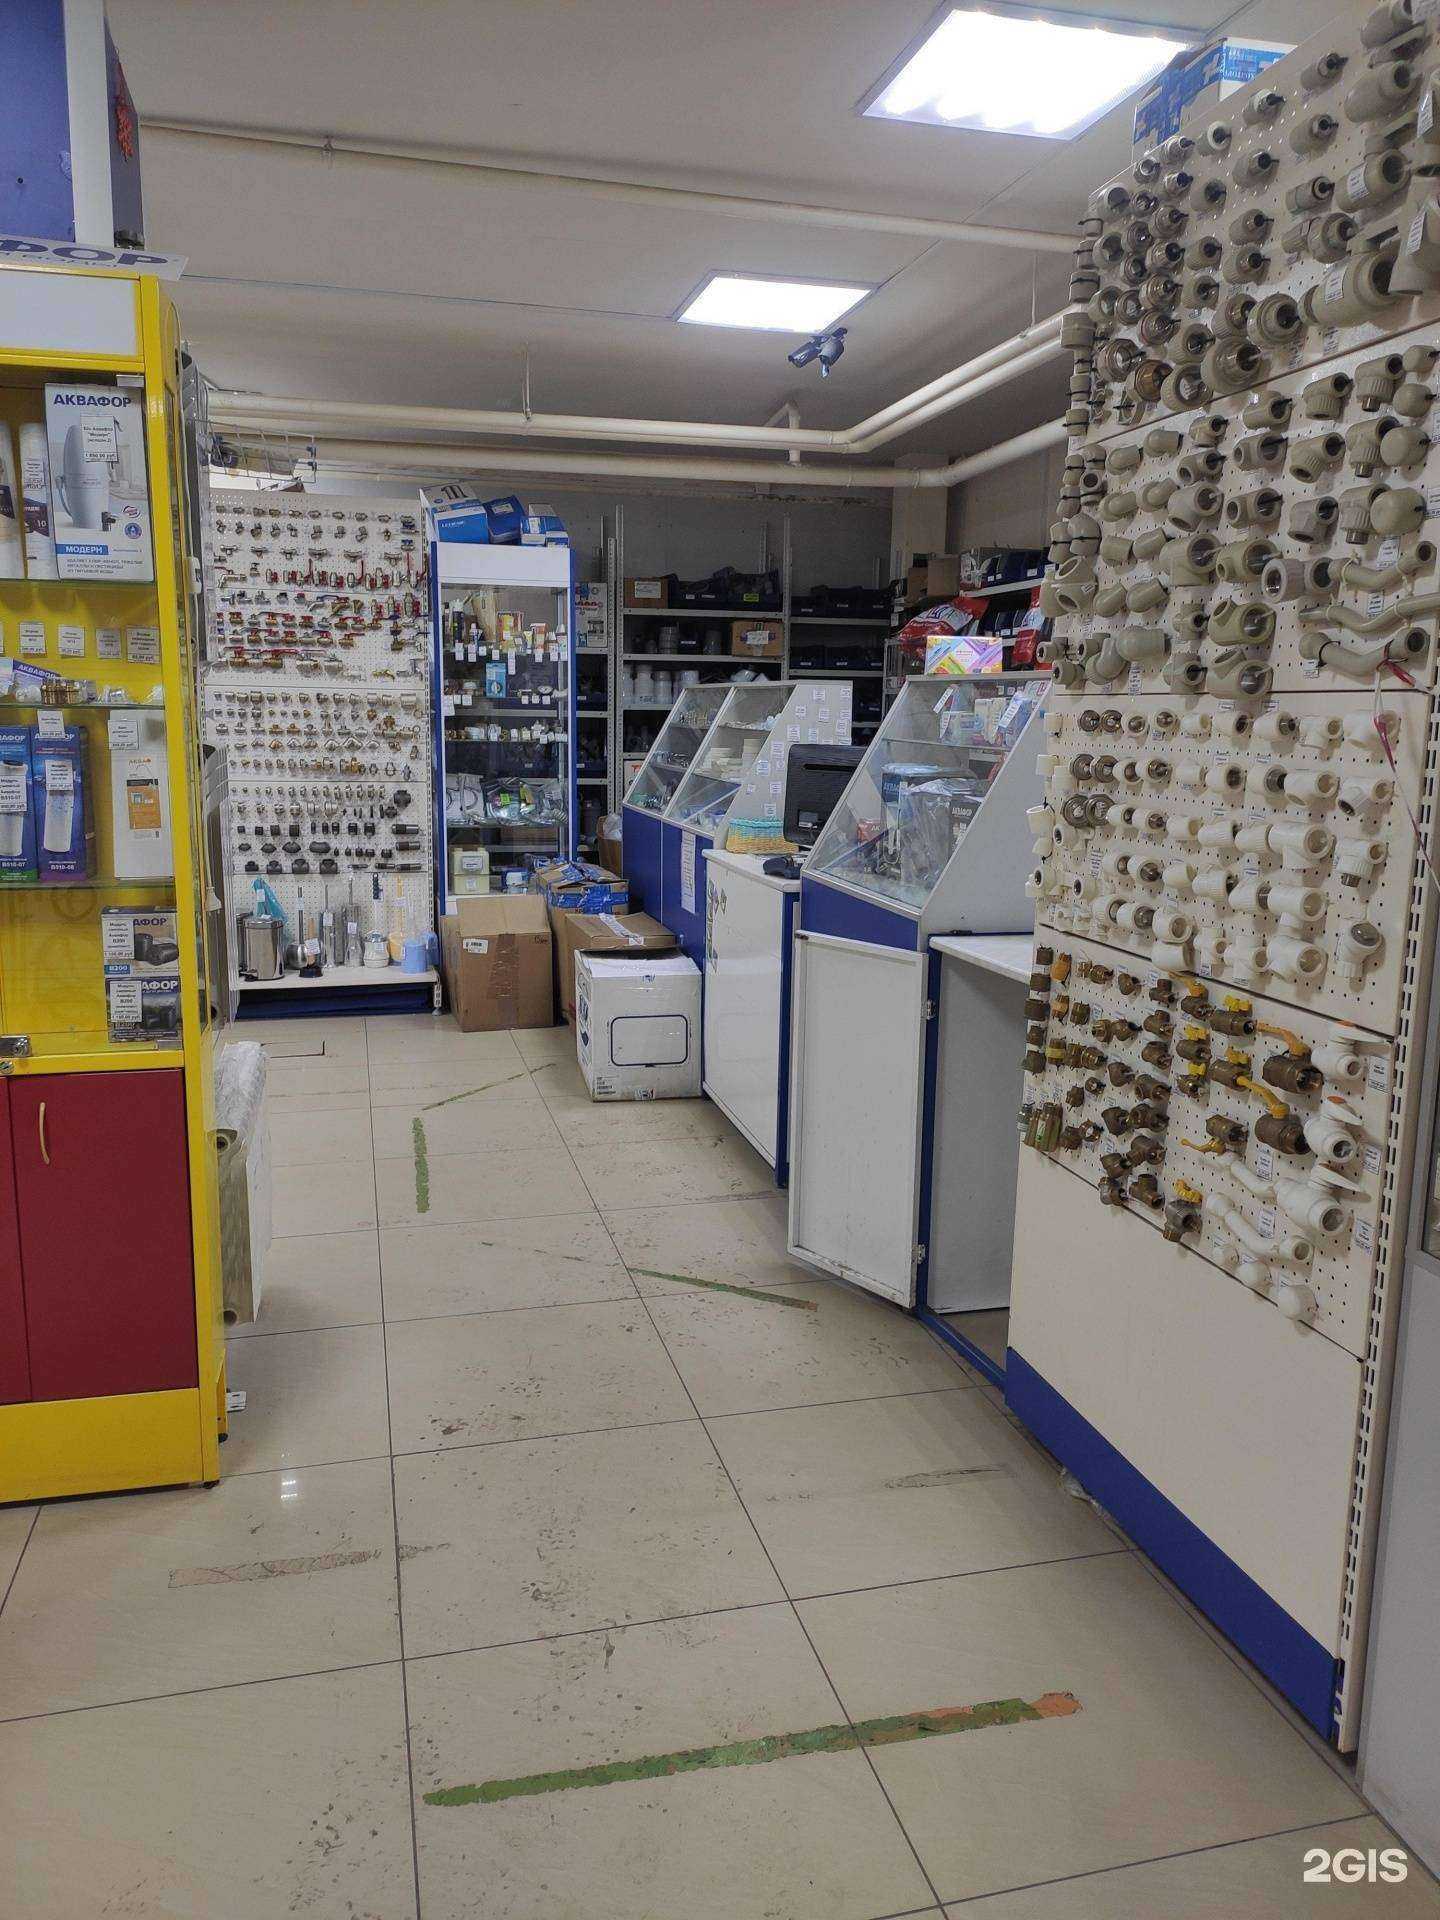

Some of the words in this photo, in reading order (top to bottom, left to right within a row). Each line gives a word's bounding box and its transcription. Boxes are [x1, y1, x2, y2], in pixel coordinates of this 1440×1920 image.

[53, 394, 132, 408] АКВАФОР
[65, 545, 103, 554] МОДЕРН
[141, 980, 178, 990] АФОР
